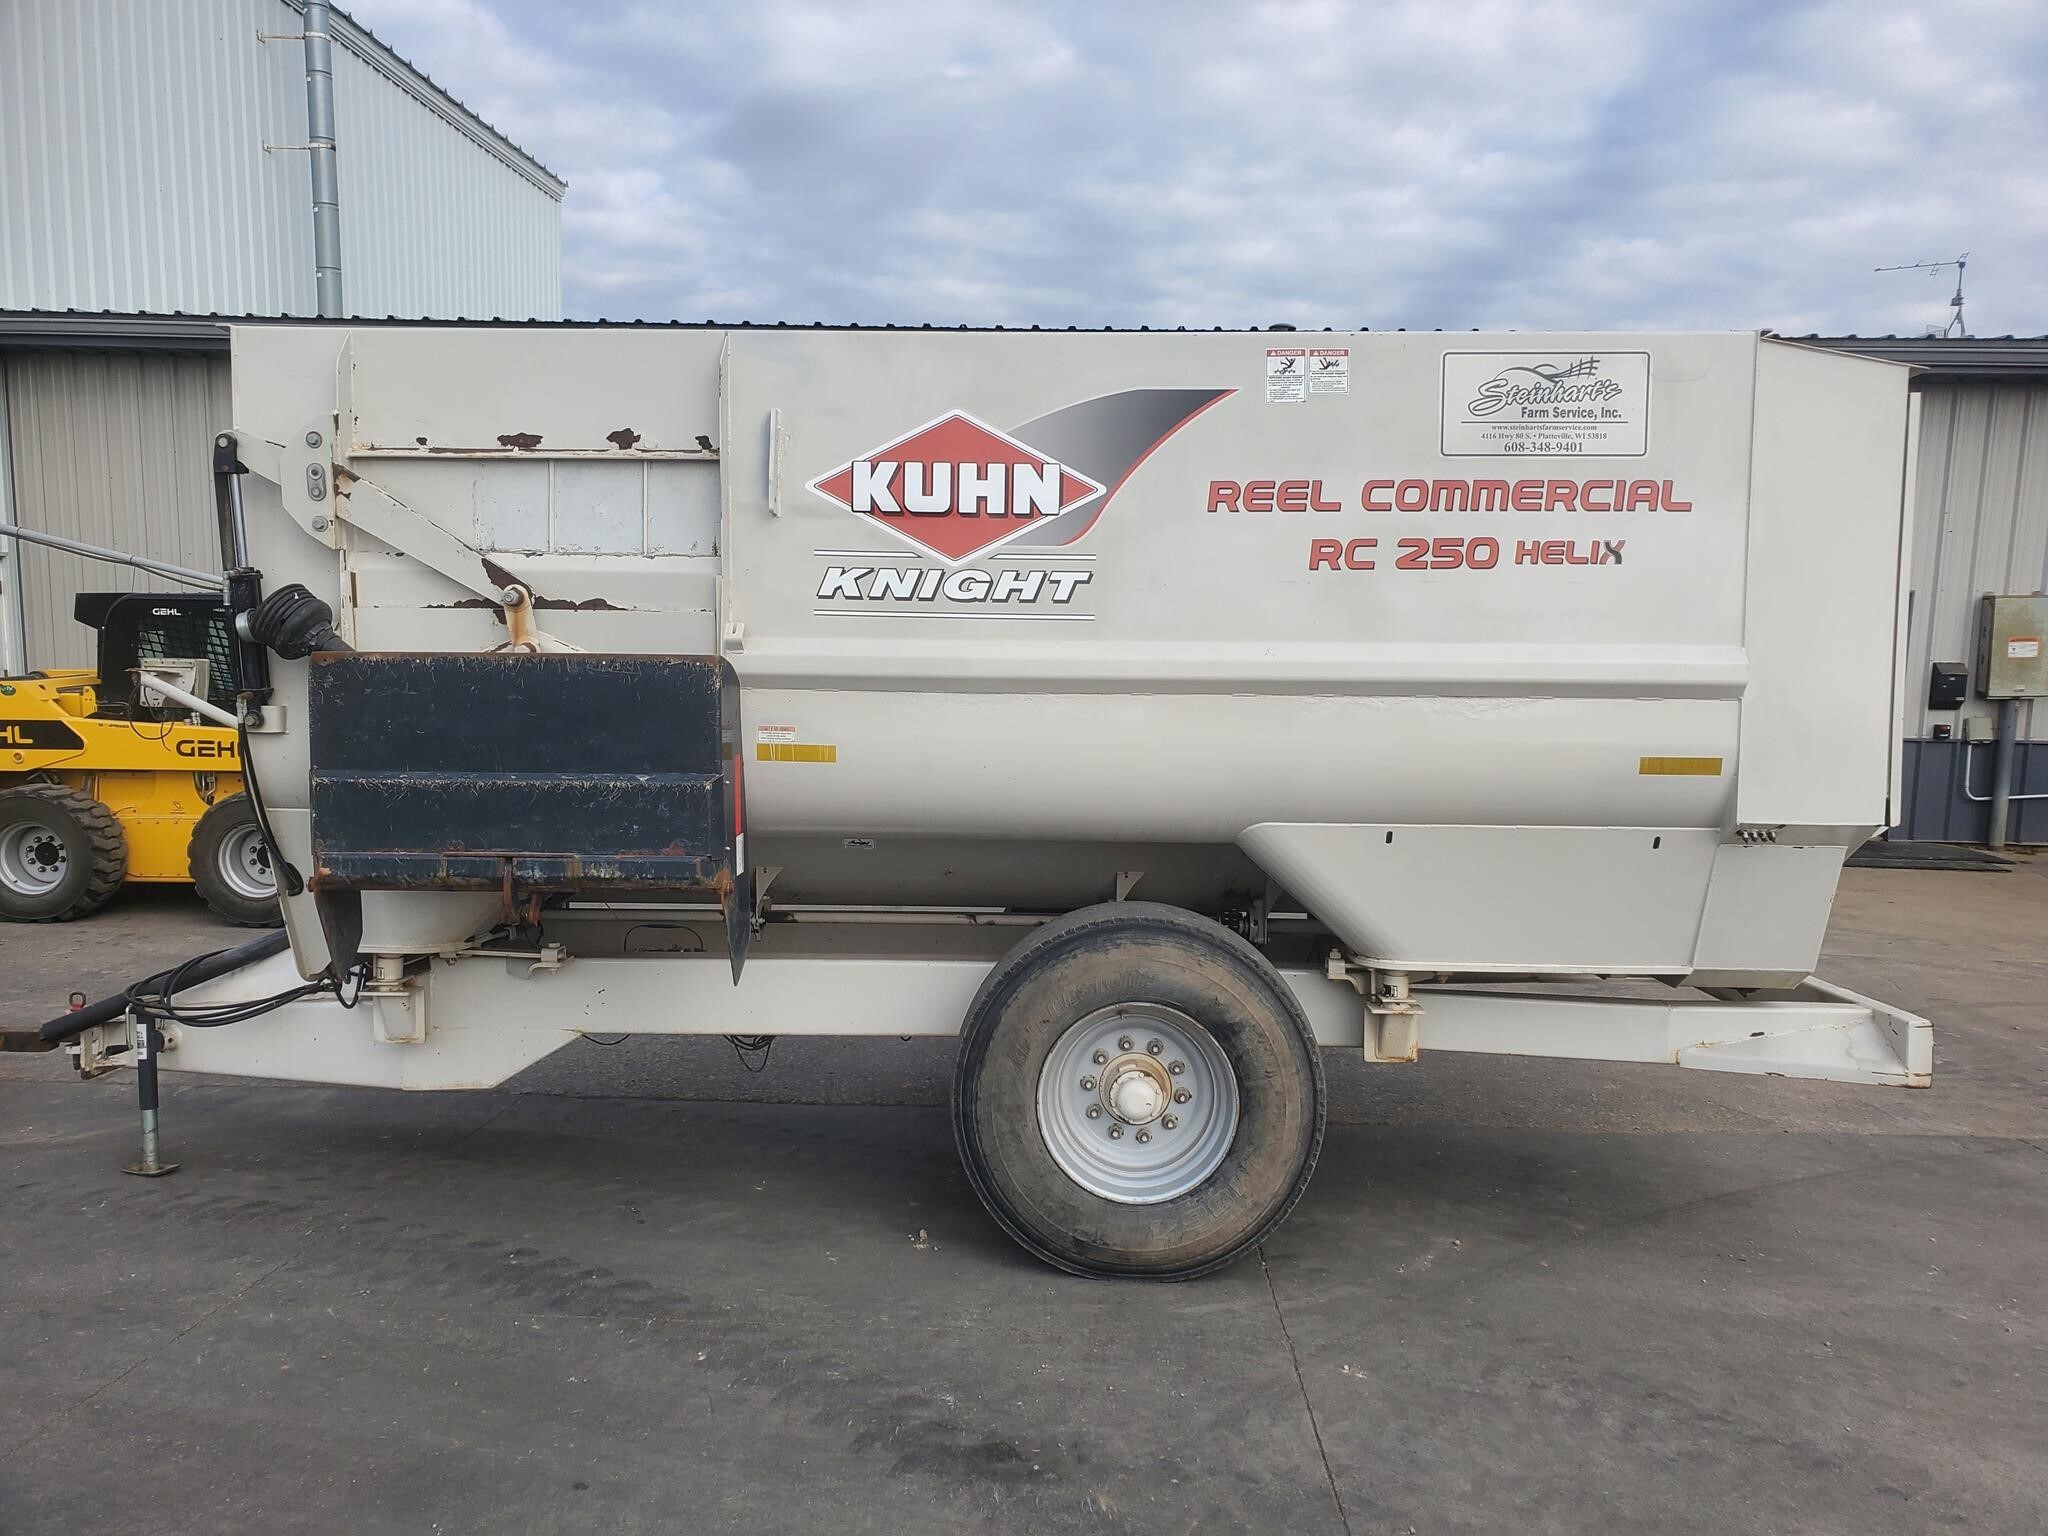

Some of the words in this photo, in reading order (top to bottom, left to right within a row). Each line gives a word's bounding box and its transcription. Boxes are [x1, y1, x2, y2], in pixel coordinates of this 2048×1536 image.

[1468, 378, 1623, 417] Steinhart's
[1521, 407, 1549, 418] Farm
[1553, 407, 1598, 420] Service,
[1601, 407, 1622, 418] Inc.
[1504, 442, 1583, 452] 608-348-9401
[852, 461, 1061, 517] KUHN
[1208, 481, 1342, 513] REEL
[1361, 479, 1693, 512] COMMERCIAL
[1309, 538, 1378, 570] RC
[1395, 537, 1500, 570] 250
[1514, 540, 1626, 565] HELIX
[816, 567, 1094, 604] KNIGHT
[152, 608, 182, 616] GEHL
[176, 739, 241, 758] GEH
